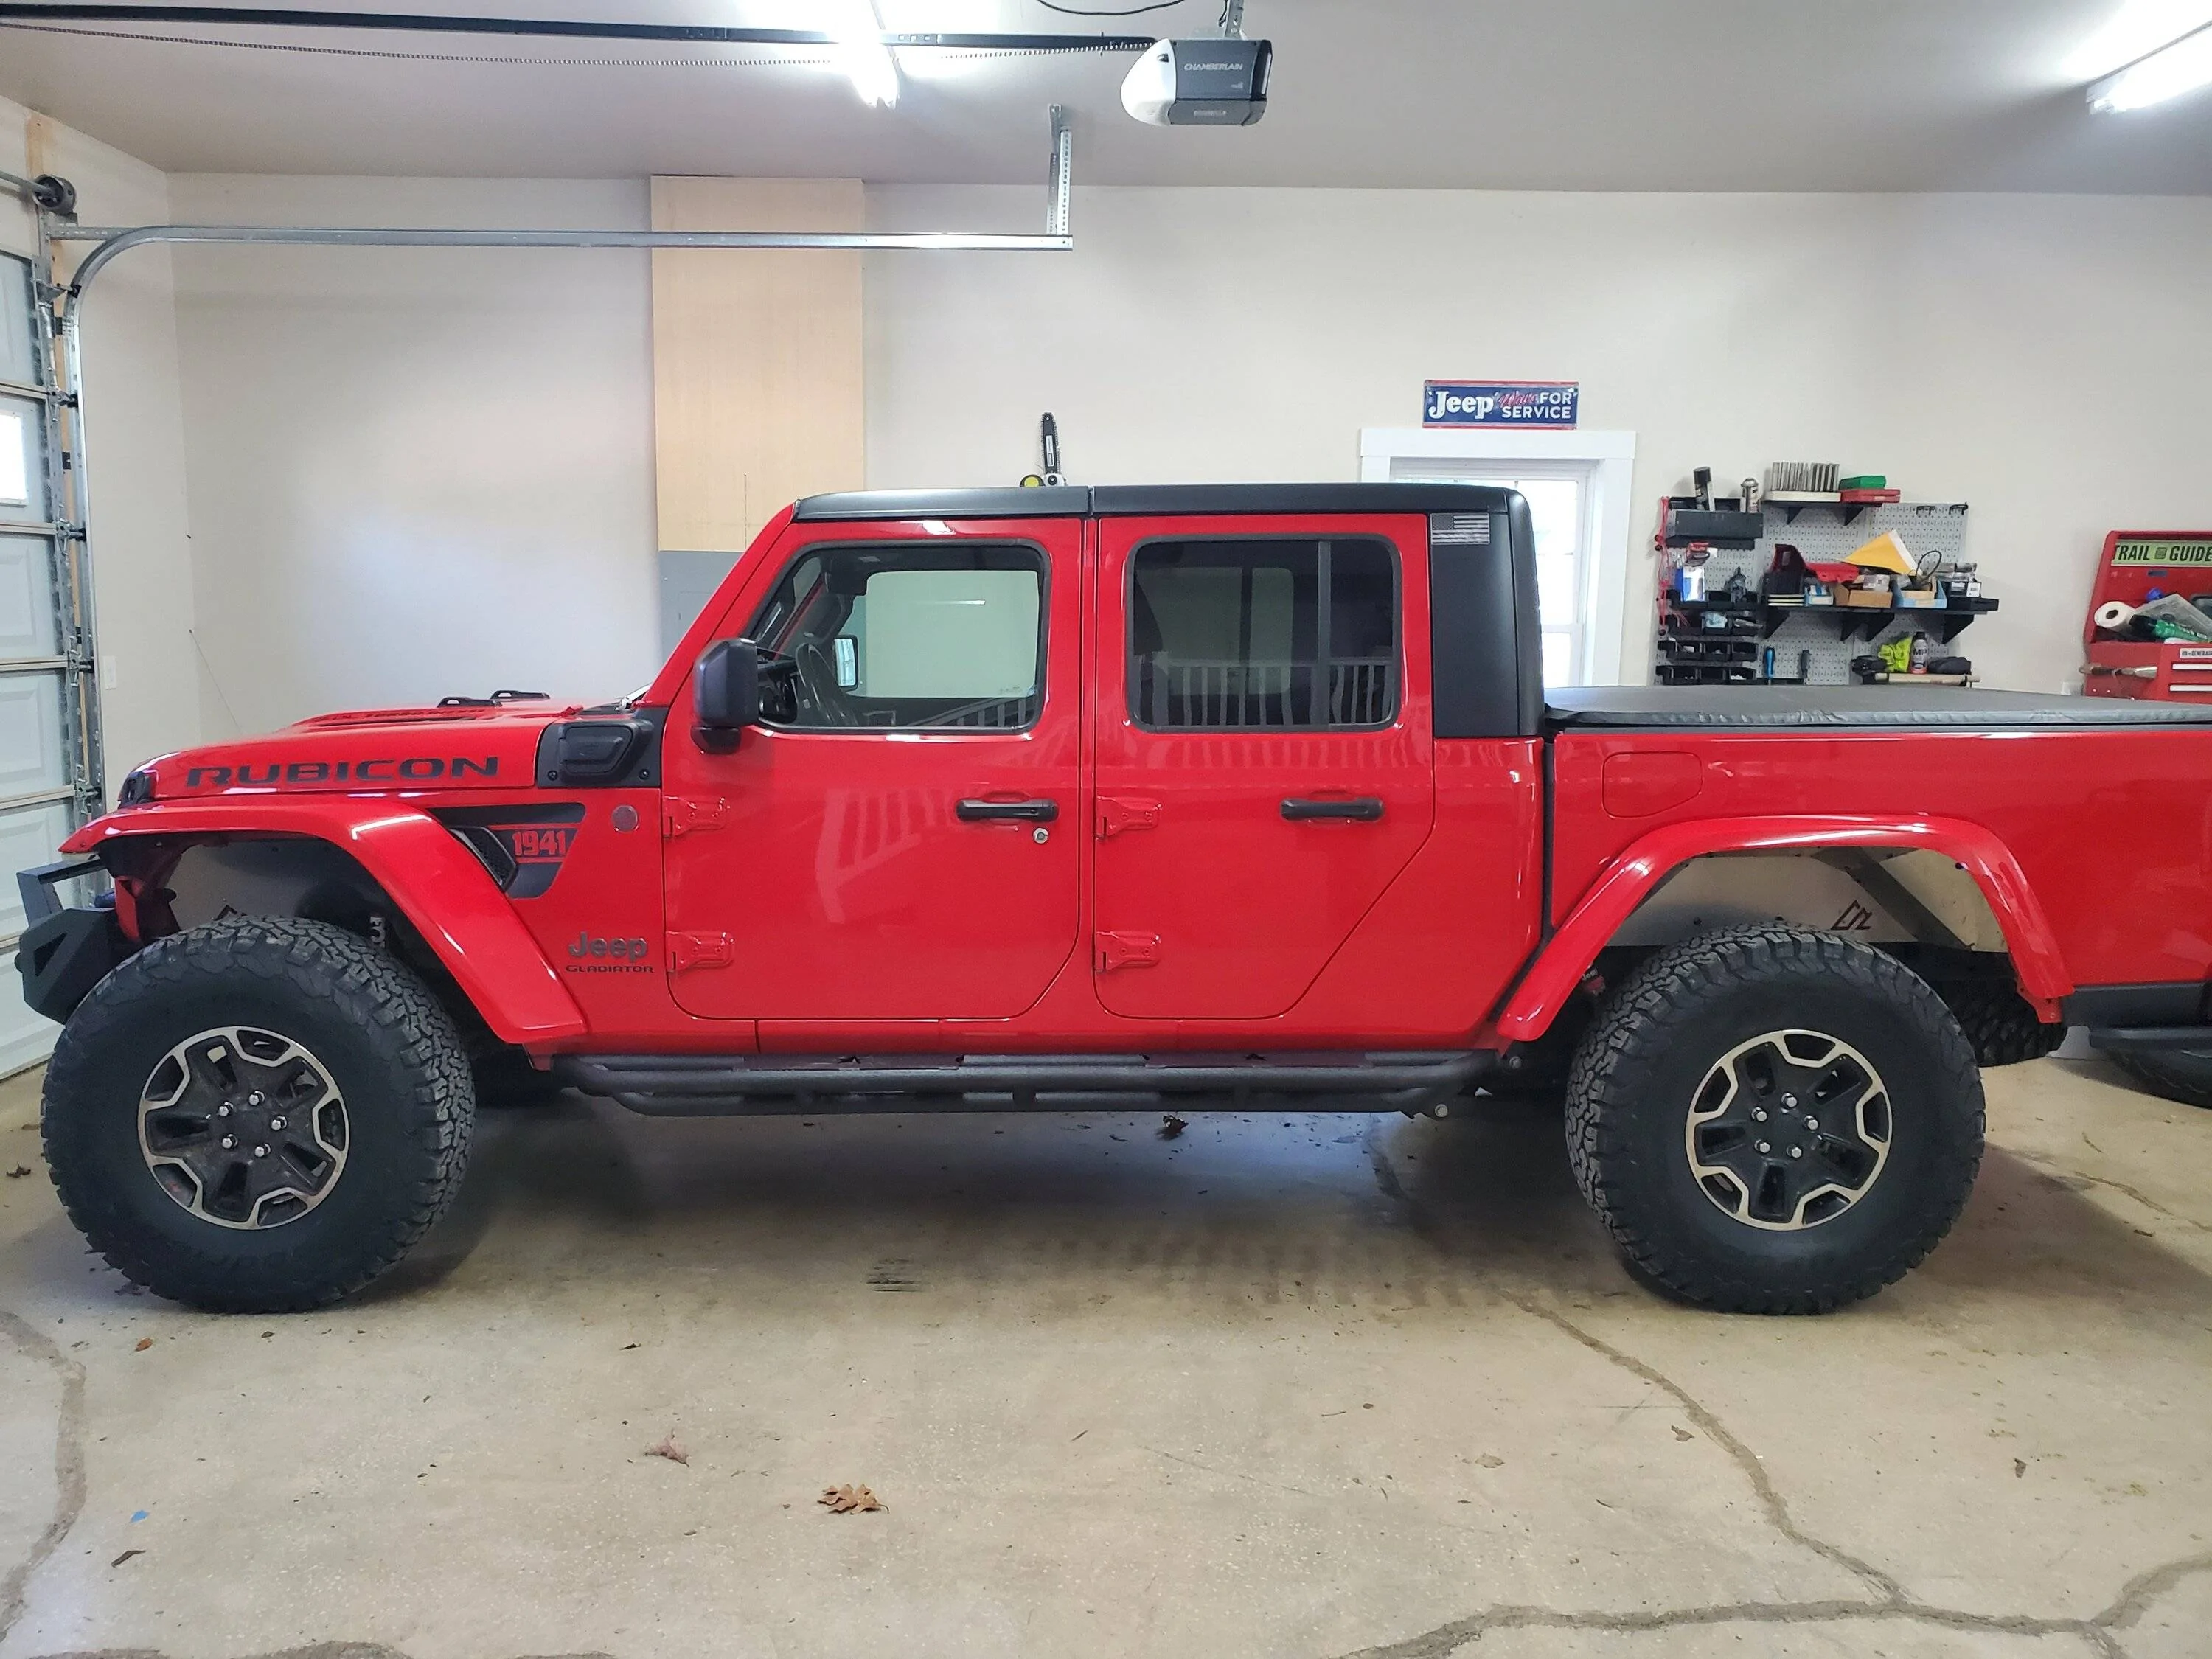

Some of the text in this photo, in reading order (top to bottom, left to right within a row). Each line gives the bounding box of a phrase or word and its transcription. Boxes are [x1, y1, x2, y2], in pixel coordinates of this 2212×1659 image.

[1540, 392, 1572, 405] FOR
[1501, 406, 1572, 419] SERVICE
[187, 756, 499, 787] RUBICON
[512, 830, 567, 855] 1941
[568, 931, 648, 964] Jeep
[566, 964, 655, 973] GLADIATOR
